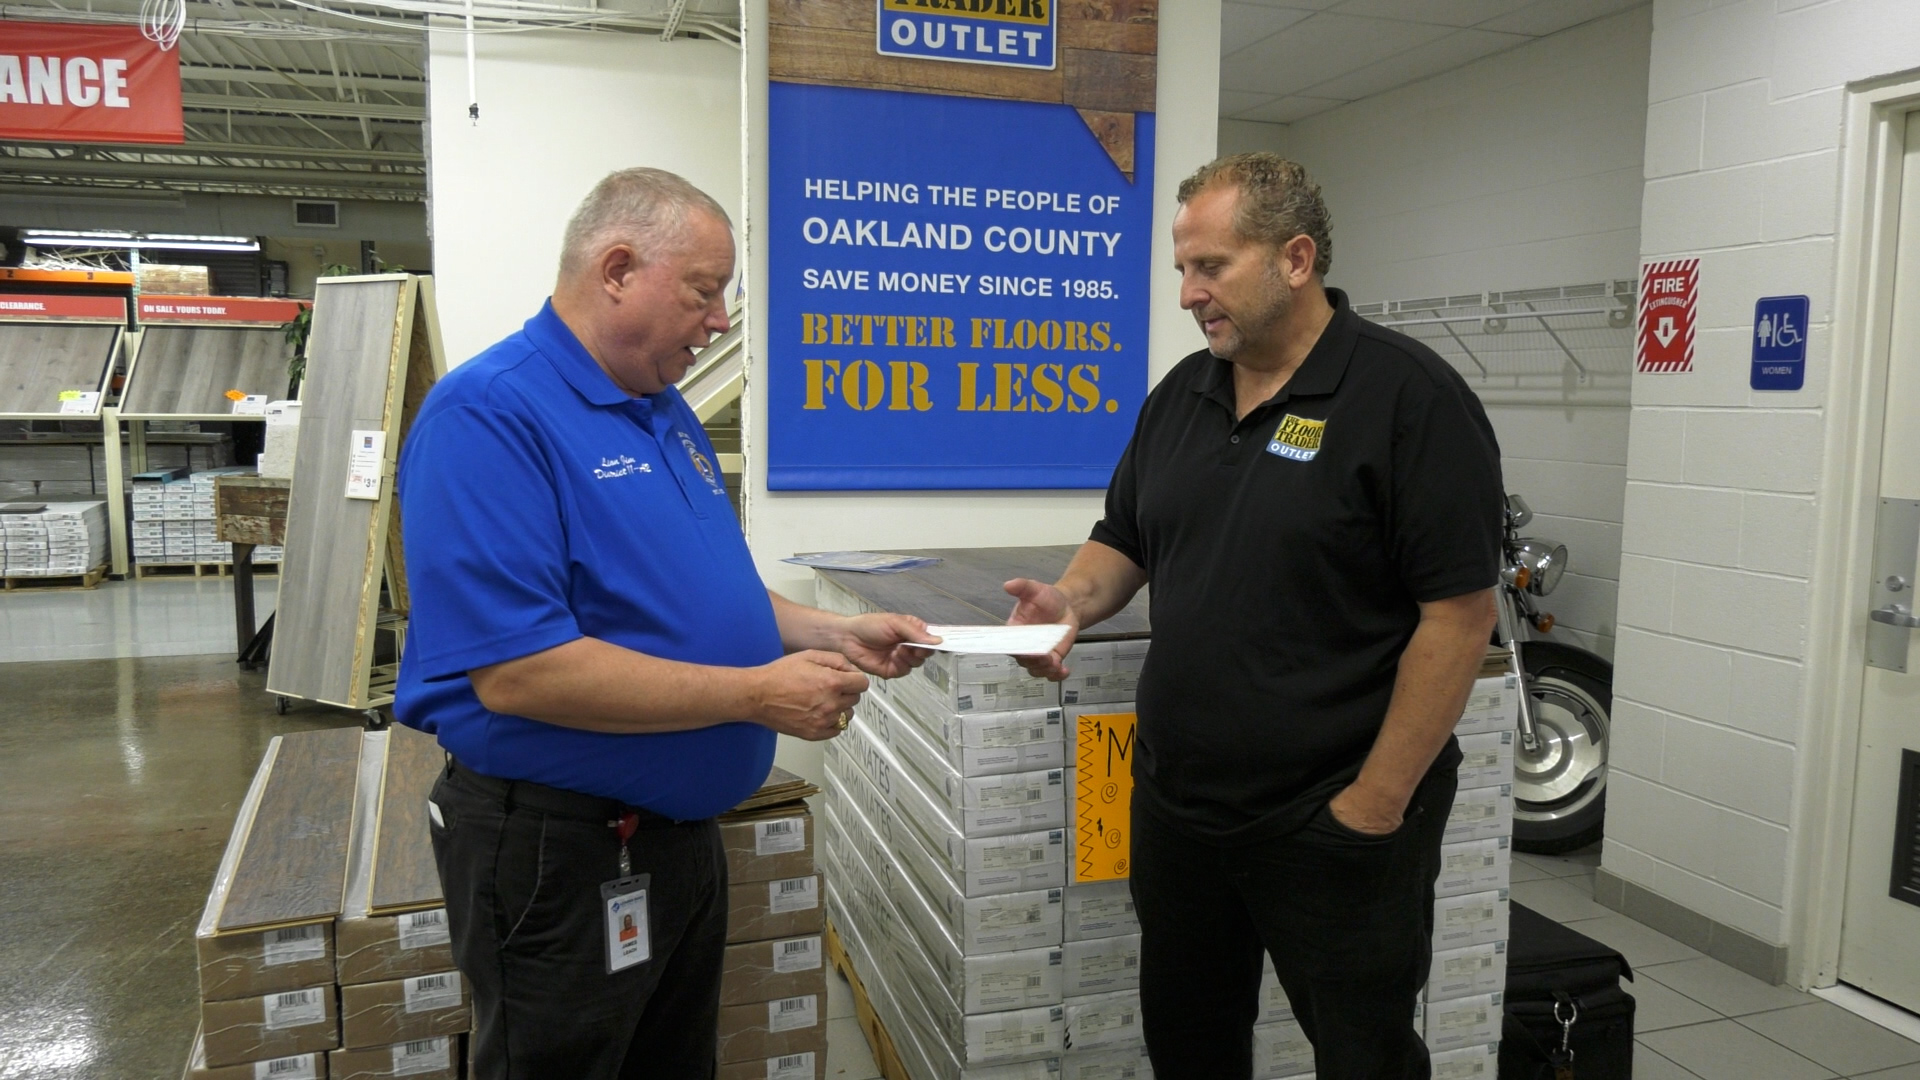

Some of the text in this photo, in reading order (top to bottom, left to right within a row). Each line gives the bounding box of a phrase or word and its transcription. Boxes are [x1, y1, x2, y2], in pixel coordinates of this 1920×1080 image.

[891, 18, 1043, 57] OUTLET
[0, 54, 130, 108] ANCE
[805, 178, 1121, 215] HELPING THE PEOPLE OF
[802, 216, 1122, 257] OAKLAND COUNTY
[87, 271, 94, 280] 3
[802, 268, 1119, 300] SAVE MONEY SINCE 1985.
[1653, 277, 1685, 294] FIRE
[0, 301, 46, 311] CLEARANCE.
[143, 304, 228, 315] ON SALE. YOURS TODAY.
[1648, 296, 1688, 311] EXTINGUISHER
[802, 313, 1122, 352] BETTER FLOORS.
[1761, 366, 1792, 375] WOMEN
[803, 359, 1119, 414] FOR LESS.
[1281, 419, 1324, 438] FLOOR
[1275, 430, 1320, 450] TRADER
[1270, 442, 1316, 460] OUTLET
